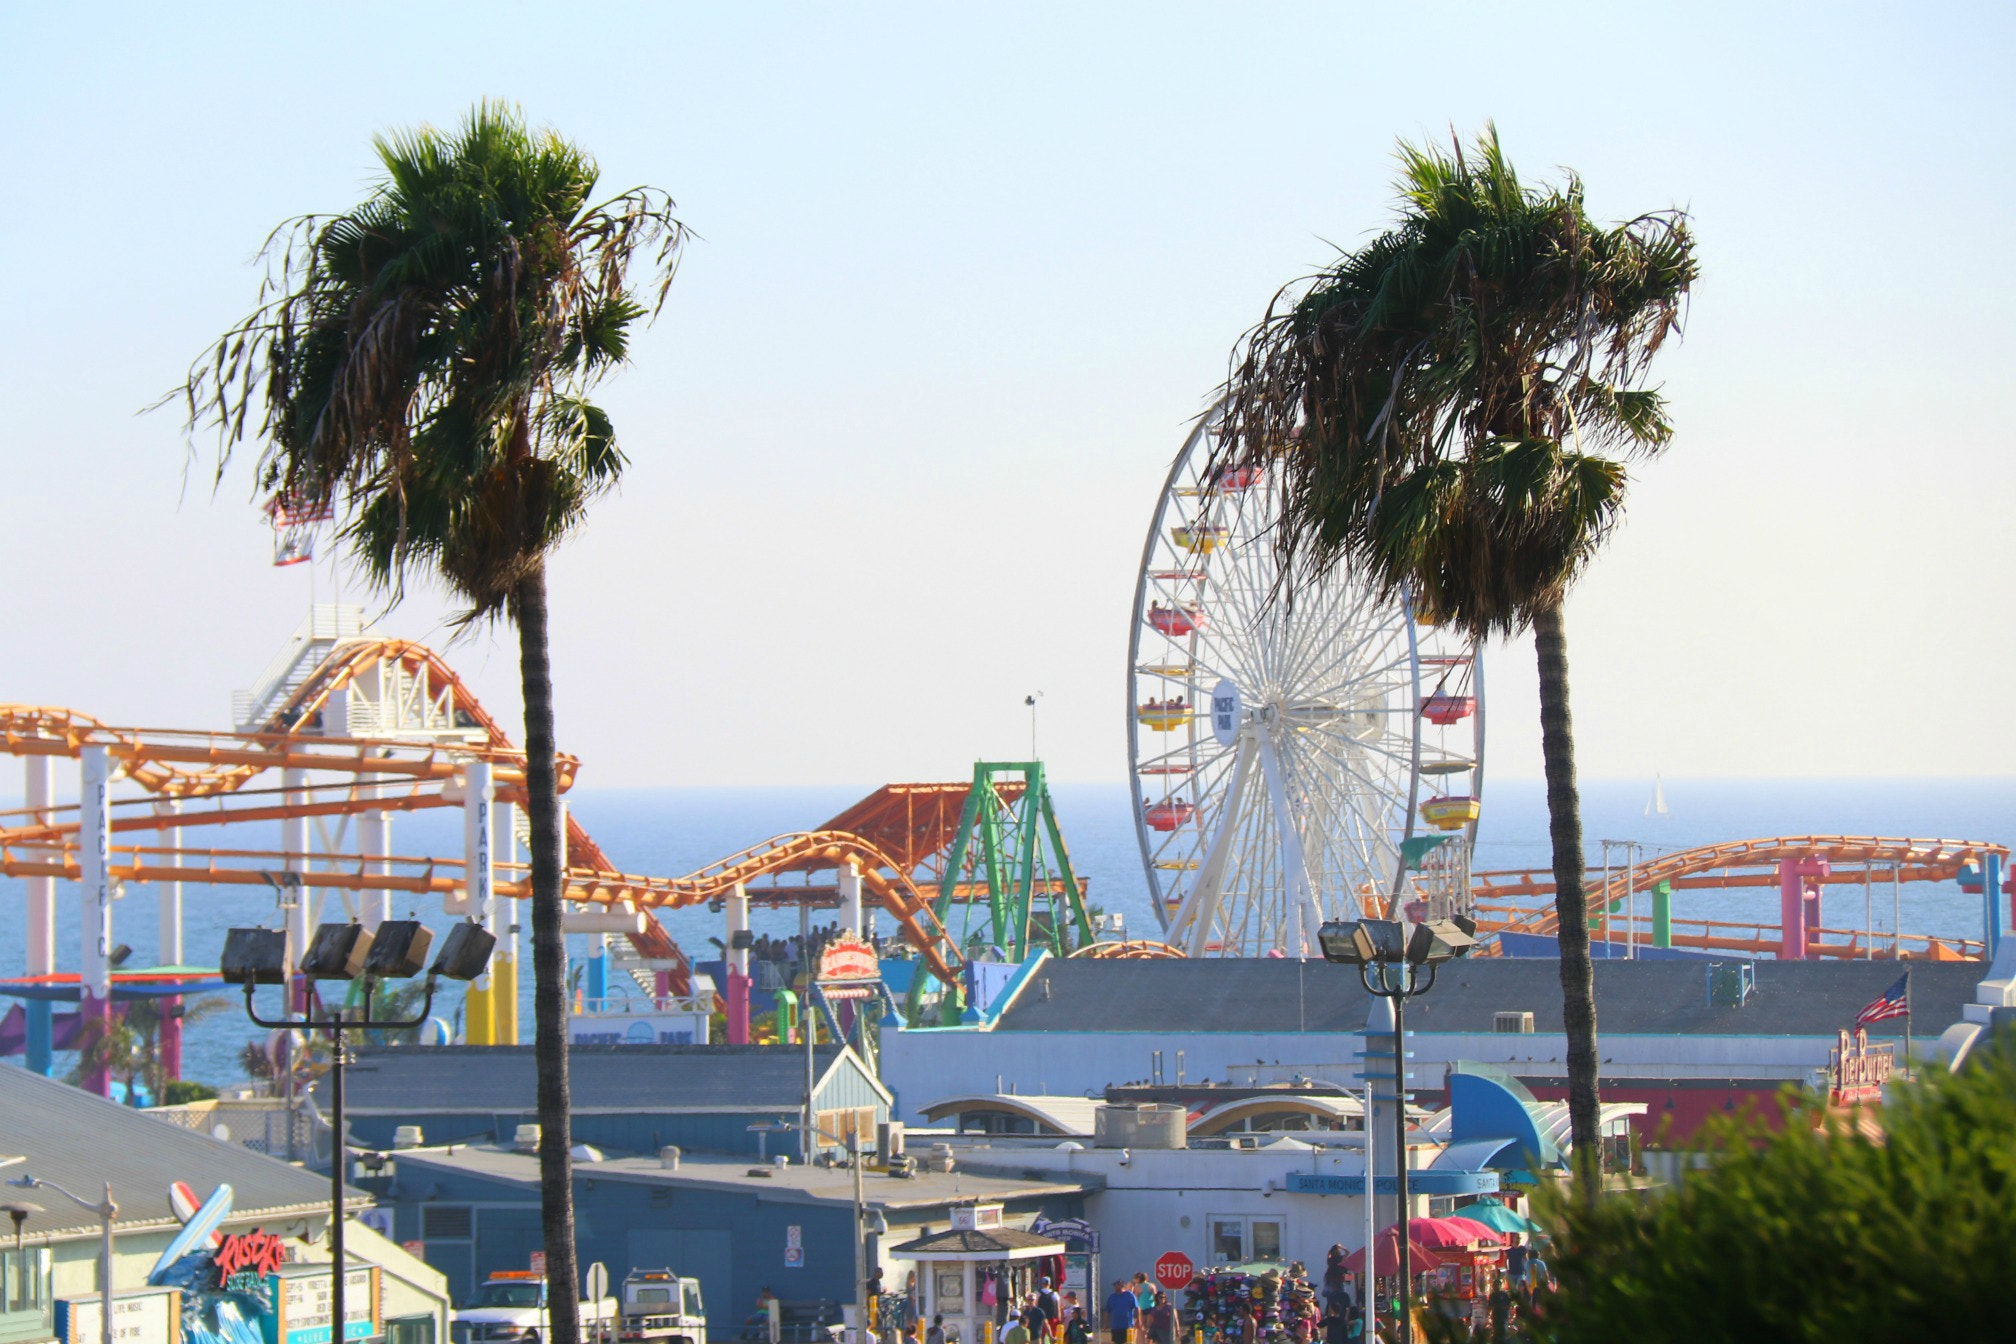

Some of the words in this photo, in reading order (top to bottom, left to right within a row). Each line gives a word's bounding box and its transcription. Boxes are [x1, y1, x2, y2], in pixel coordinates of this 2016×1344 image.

[478, 803, 488, 899] PARK
[1299, 1178, 1326, 1190] SANTA
[1328, 1179, 1368, 1191] MONIC
[1376, 1180, 1419, 1191] POLCE
[1062, 1229, 1090, 1240] MONICA
[1157, 1263, 1191, 1279] STOP
[303, 1331, 323, 1343] LIVE
